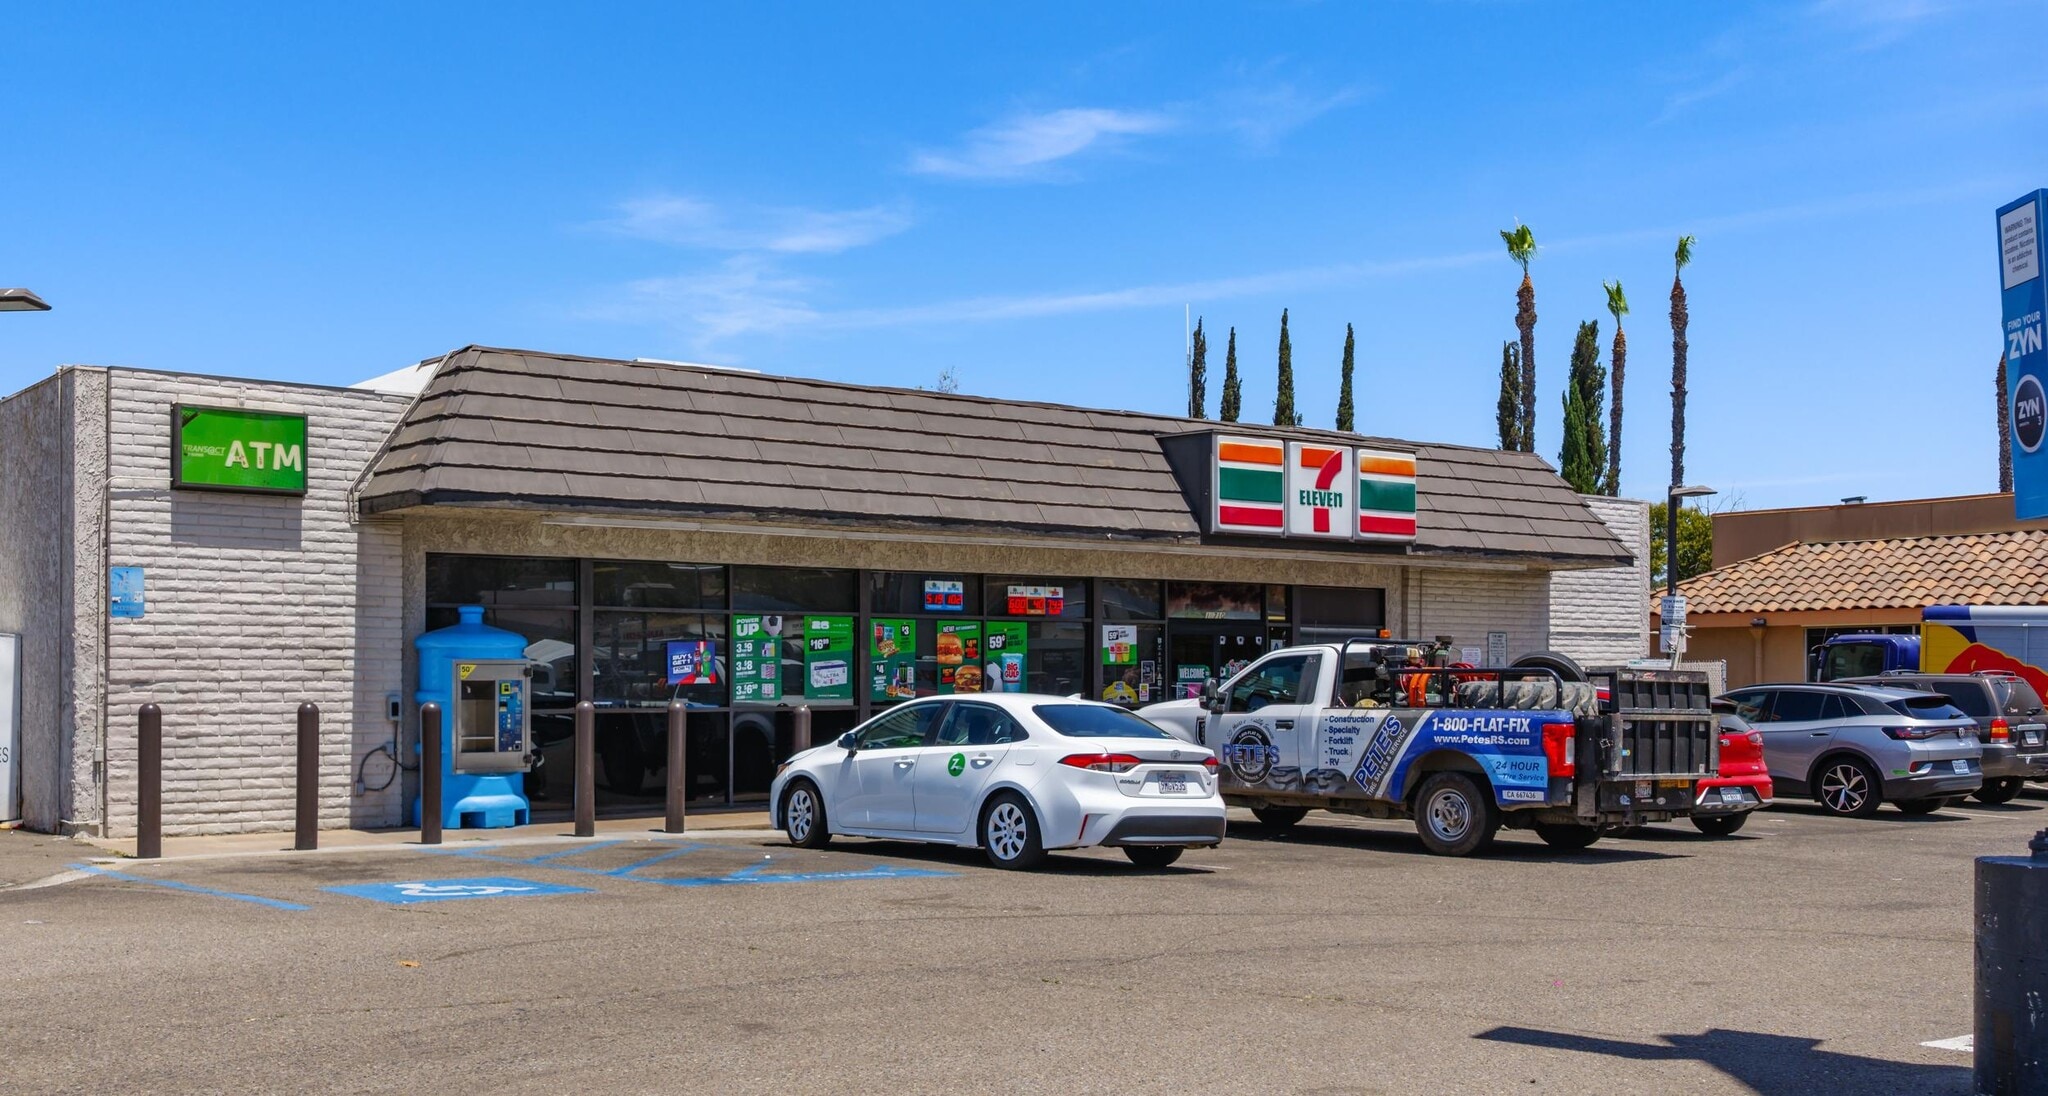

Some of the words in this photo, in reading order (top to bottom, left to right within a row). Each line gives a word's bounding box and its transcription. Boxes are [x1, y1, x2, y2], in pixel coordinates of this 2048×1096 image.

[2008, 318, 2021, 331] FIND
[2022, 311, 2041, 325] YOUR
[2008, 323, 2042, 360] ZYN
[2017, 397, 2040, 420] ZYN
[225, 440, 302, 472] ATM
[1301, 447, 1343, 533] 7
[736, 623, 760, 636] UP
[989, 635, 1005, 649] 59¢
[1006, 662, 1018, 671] BIG
[1179, 667, 1205, 679] WELCOME
[1004, 670, 1019, 678] GULP
[1328, 715, 1374, 723] Construction
[1432, 717, 1530, 733] 1-800-FLAT-FIX
[1328, 726, 1360, 735] Specialty
[1328, 737, 1353, 745] Forklift
[1434, 734, 1530, 745] www.PetesRS.com
[1222, 743, 1280, 764] PETE'S
[1329, 747, 1348, 755] Truck
[1354, 715, 1402, 792] PETE'S
[1367, 782, 1378, 796] TIRE
[1373, 761, 1389, 782] SALES
[1389, 727, 1408, 756] SERVICE
[1495, 761, 1508, 770] 24
[1511, 761, 1540, 771] HOUR
[1519, 773, 1544, 781] Service
